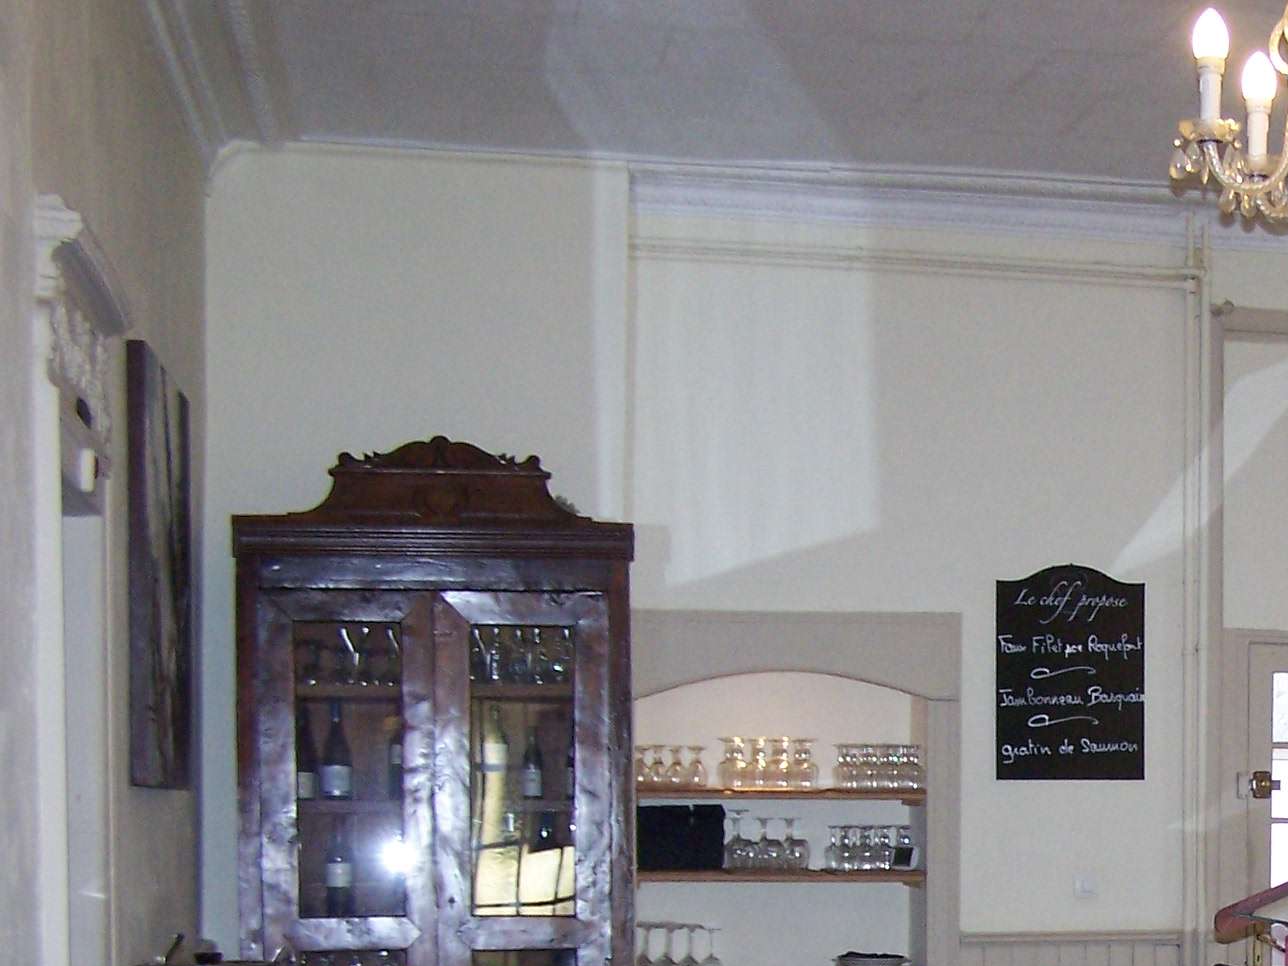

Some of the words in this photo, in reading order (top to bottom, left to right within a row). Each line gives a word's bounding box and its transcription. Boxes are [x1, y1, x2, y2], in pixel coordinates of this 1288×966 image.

[1014, 588, 1036, 606] Le
[1068, 594, 1129, 622] propose
[1032, 634, 1062, 654] Filet
[1058, 738, 1075, 755] de
